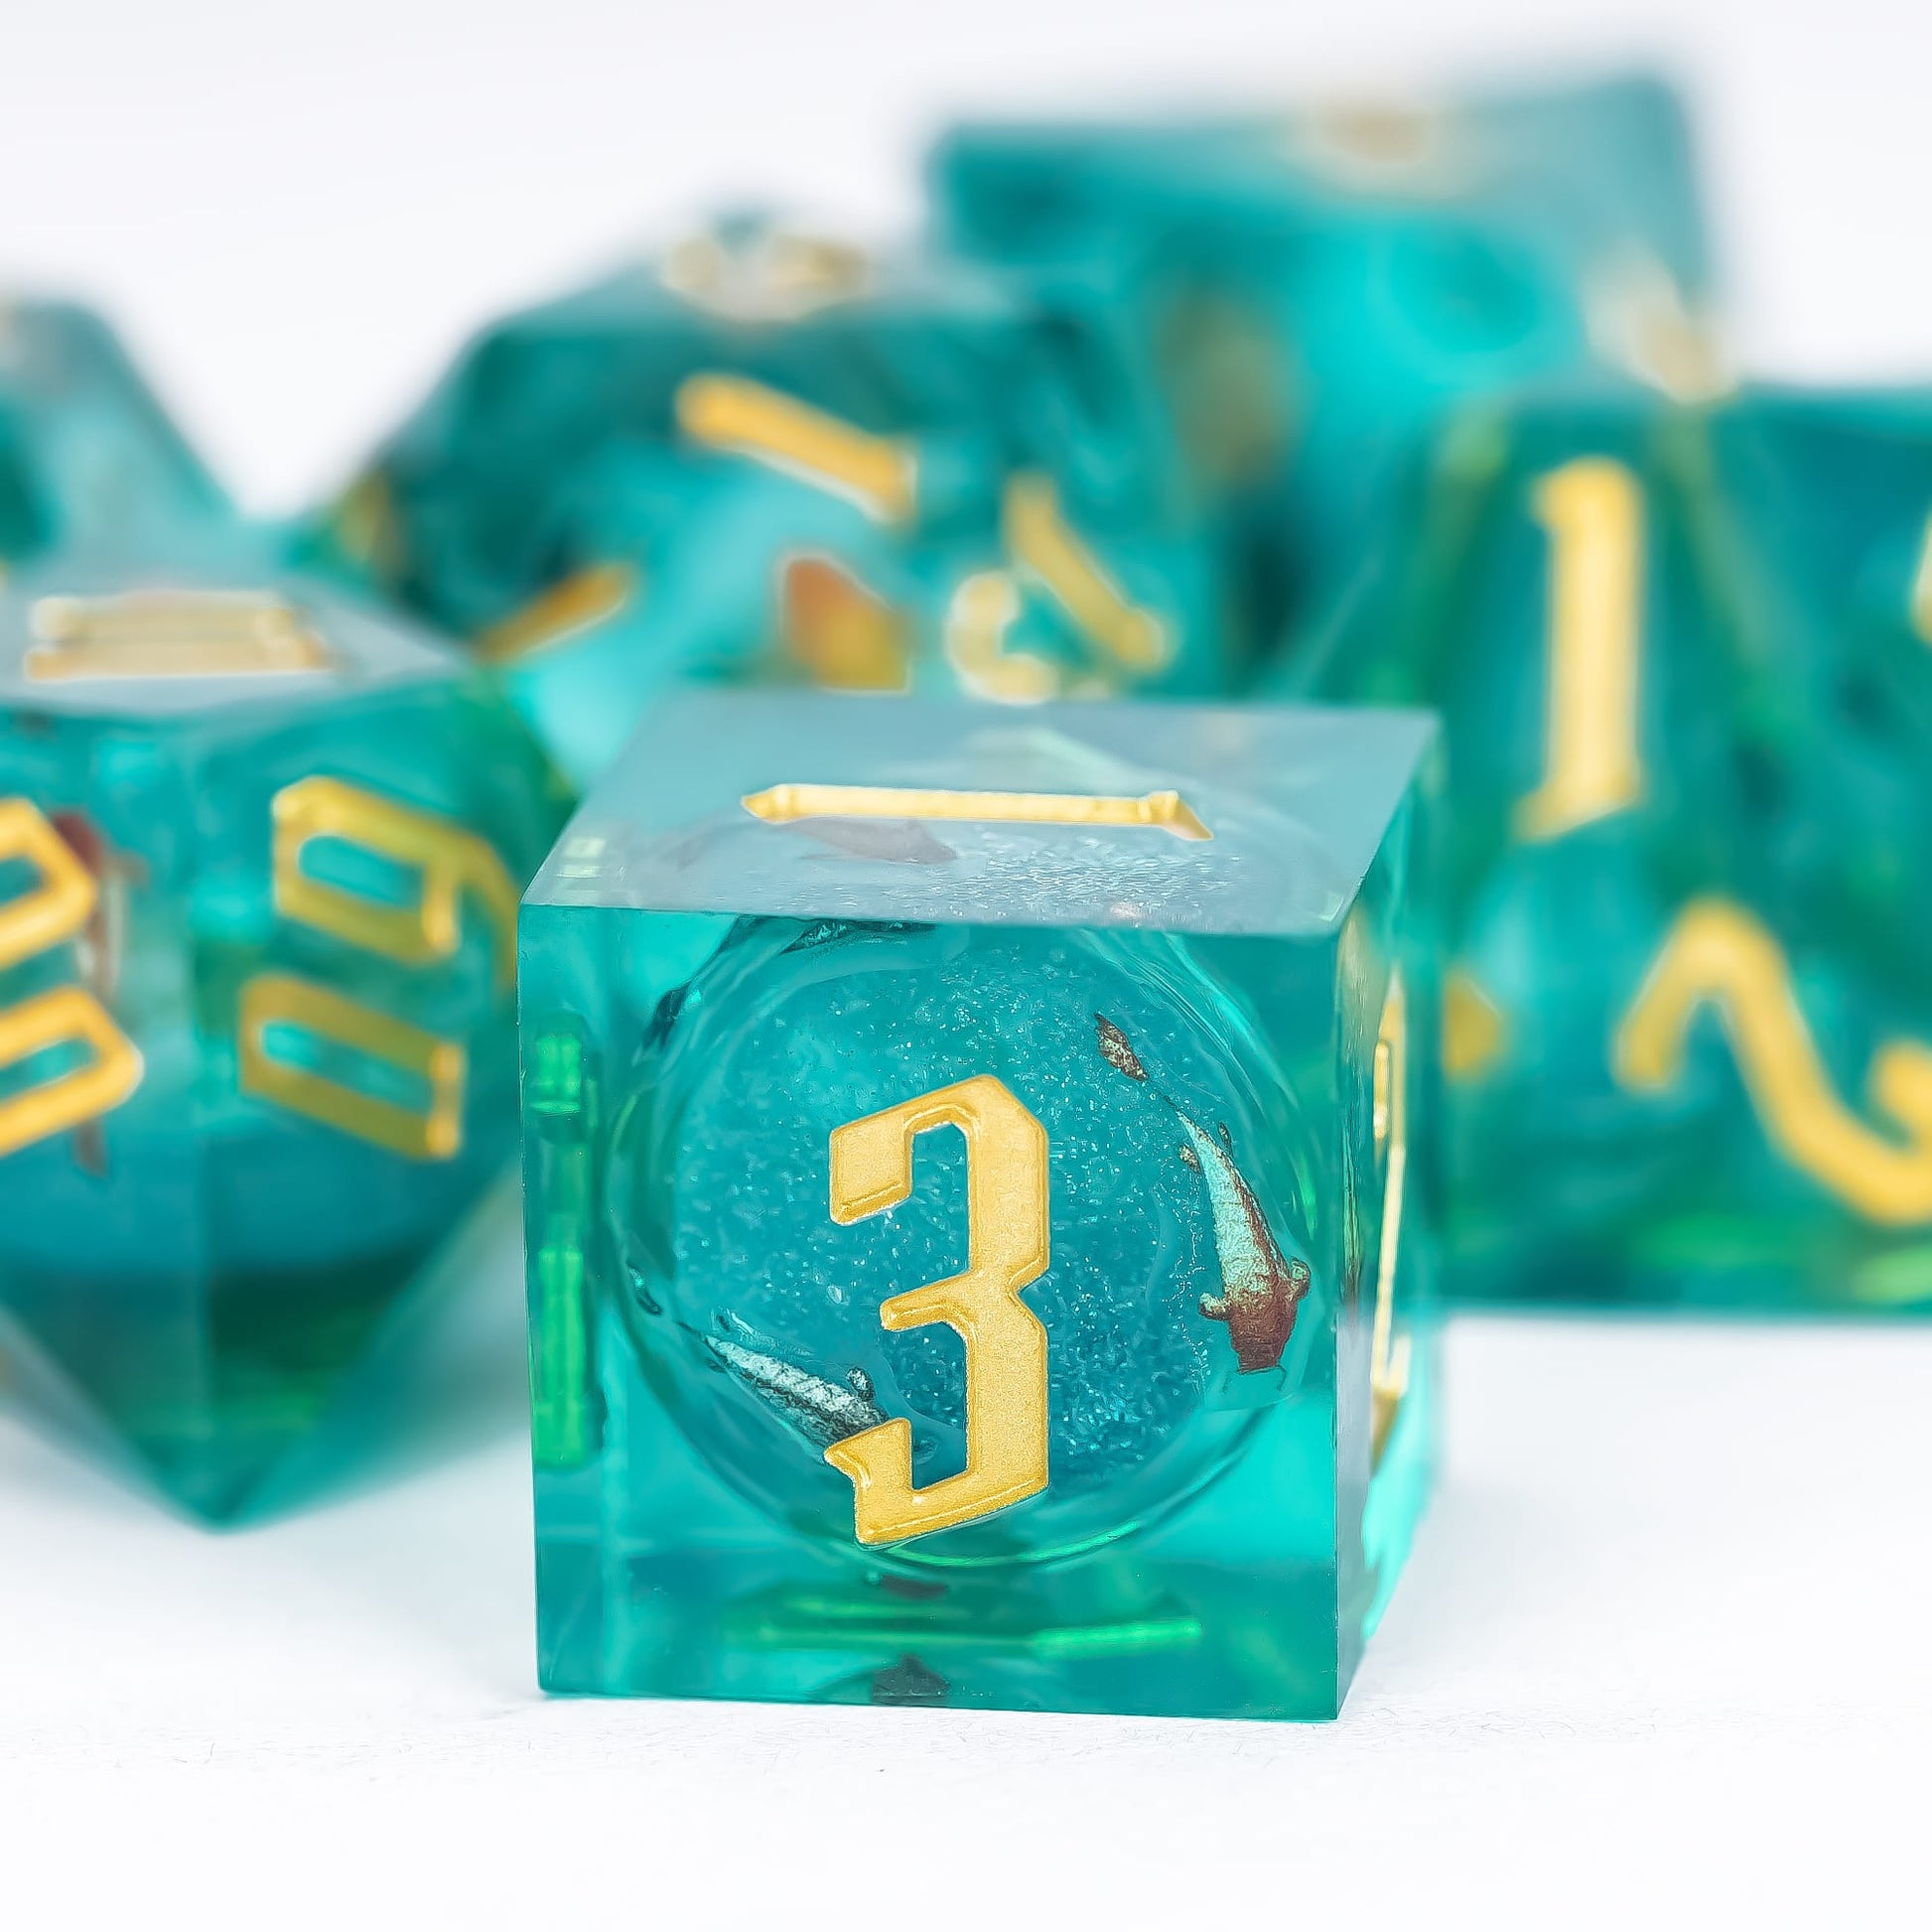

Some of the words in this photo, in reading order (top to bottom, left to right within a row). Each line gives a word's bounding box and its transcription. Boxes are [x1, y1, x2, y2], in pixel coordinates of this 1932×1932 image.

[743, 782, 1213, 842] 1
[1515, 457, 1643, 840] 1
[824, 1074, 1049, 1546] 3
